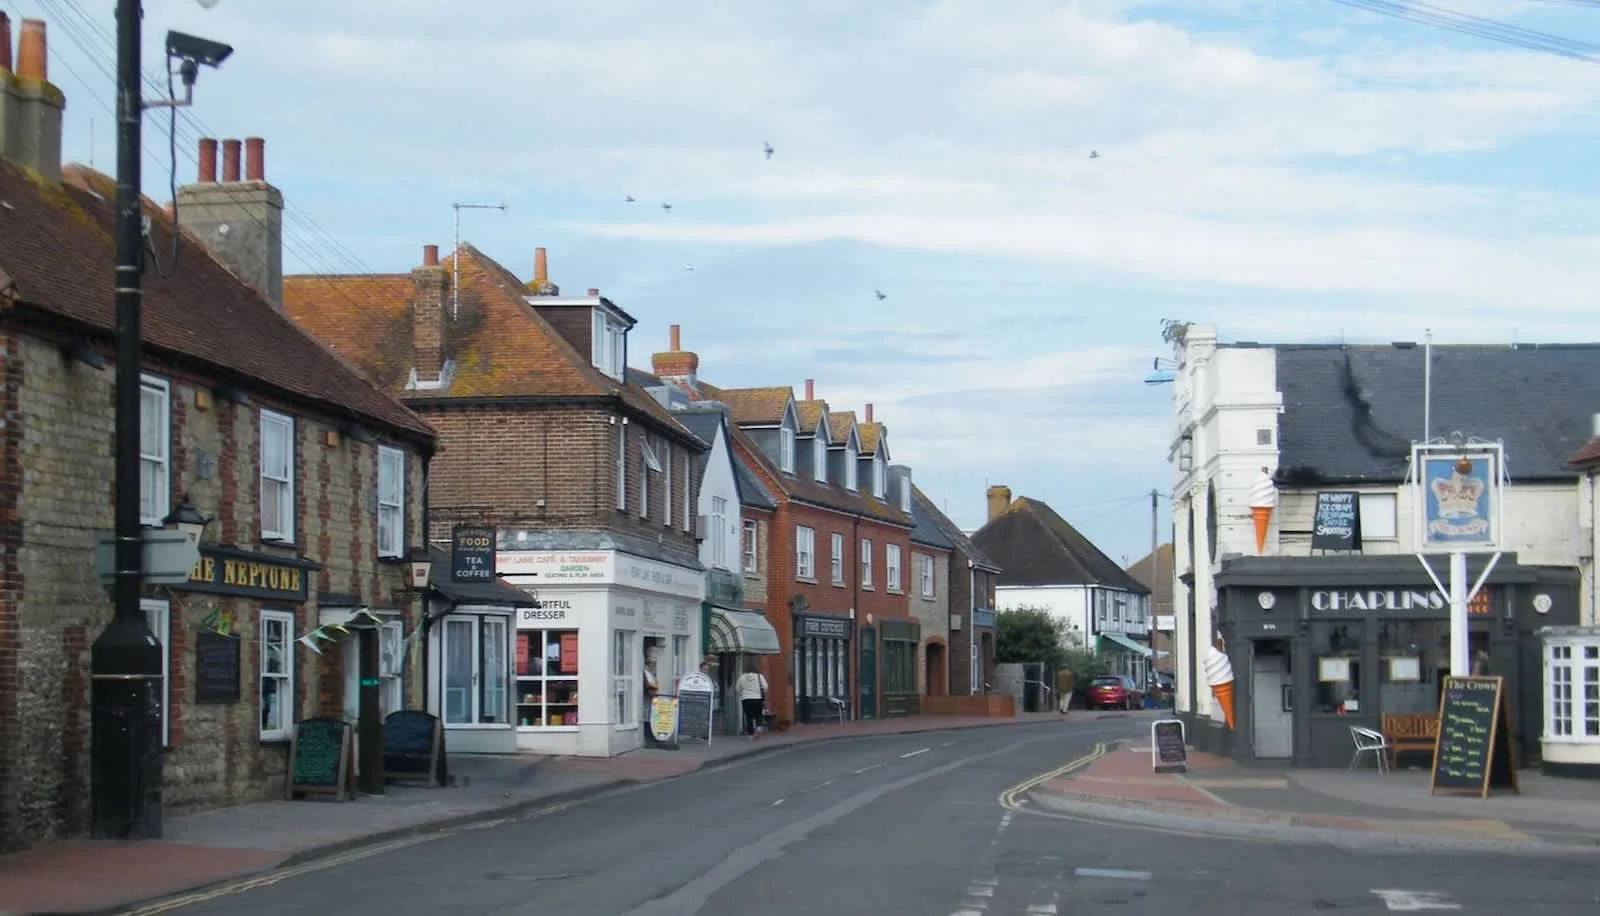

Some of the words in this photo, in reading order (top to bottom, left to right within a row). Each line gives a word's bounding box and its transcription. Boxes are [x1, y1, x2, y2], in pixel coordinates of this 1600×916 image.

[460, 537, 490, 546] FOOD
[223, 560, 300, 591] NEPTUNE
[1311, 591, 1444, 611] CHAPLINS
[523, 611, 566, 620] DRESSER
[1448, 680, 1465, 690] The
[1466, 681, 1497, 691] Crown
